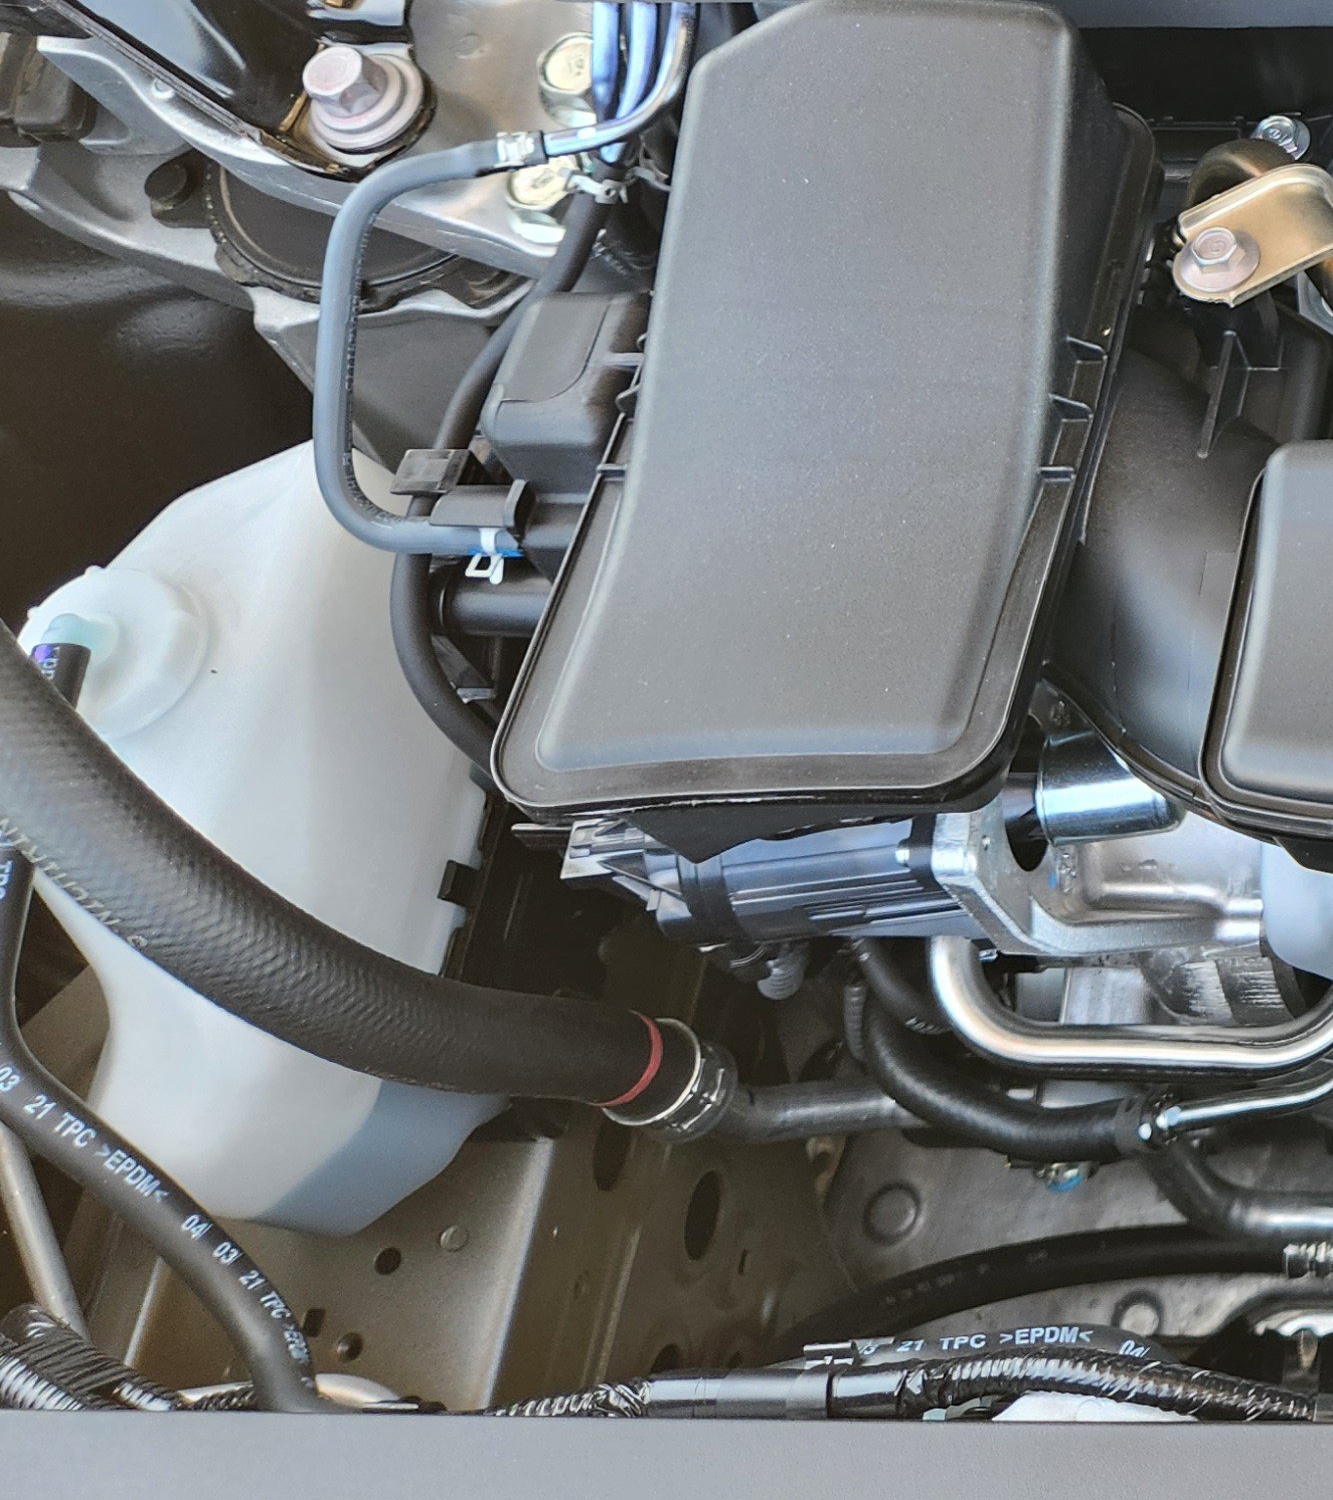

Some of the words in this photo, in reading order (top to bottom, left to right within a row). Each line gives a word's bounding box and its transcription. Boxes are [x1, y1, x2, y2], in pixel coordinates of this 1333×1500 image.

[23, 1093, 57, 1121] 21
[53, 1111, 97, 1149] TPC
[94, 1142, 170, 1204] >EPDM<
[939, 1333, 988, 1350] TPC
[999, 1325, 1095, 1345] >EPDM<
